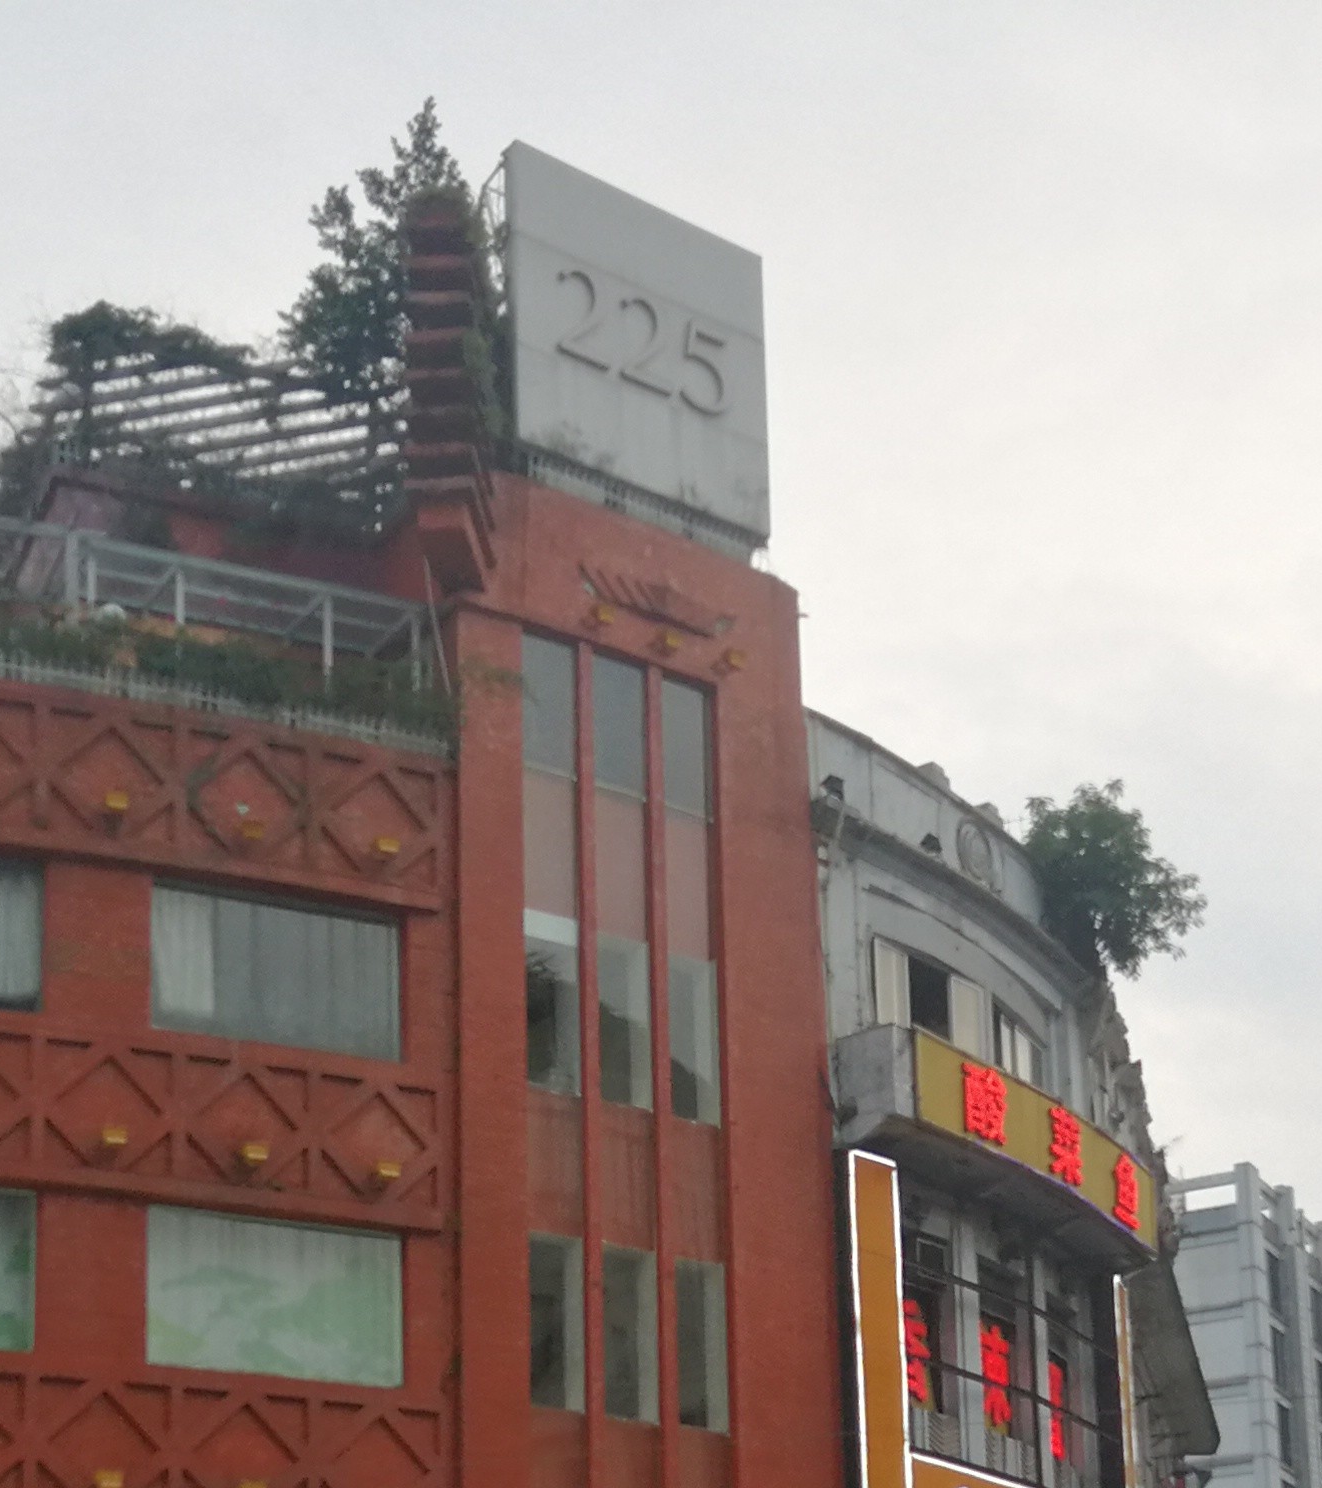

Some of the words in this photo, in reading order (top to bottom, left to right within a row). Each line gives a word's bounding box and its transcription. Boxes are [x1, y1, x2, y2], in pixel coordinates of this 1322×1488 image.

[554, 270, 728, 418] 225
[960, 1061, 1141, 1231] 酸菜鱼
